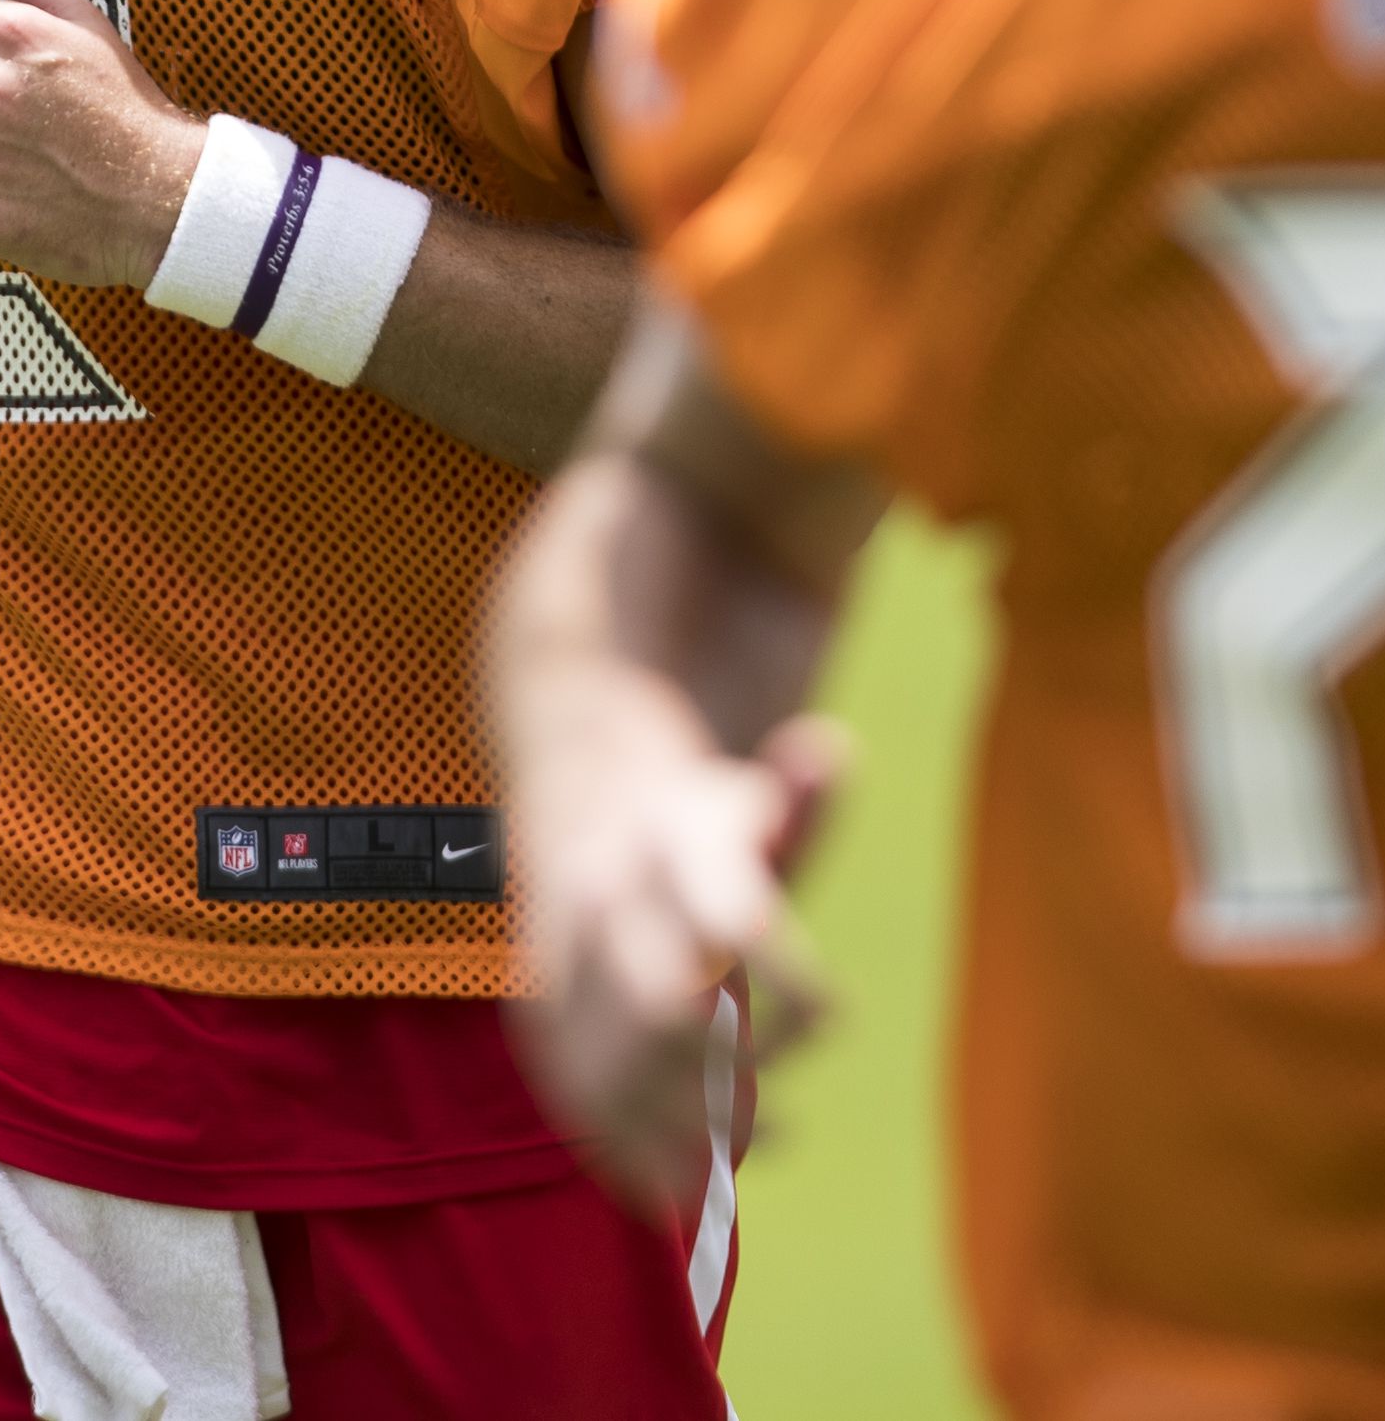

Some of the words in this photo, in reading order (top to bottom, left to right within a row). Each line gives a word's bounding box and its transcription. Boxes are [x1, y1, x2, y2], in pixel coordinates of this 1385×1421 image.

[266, 201, 302, 276] Proverbs
[292, 162, 315, 200] 3:5-6
[367, 818, 395, 851] L
[223, 845, 254, 871] NFL
